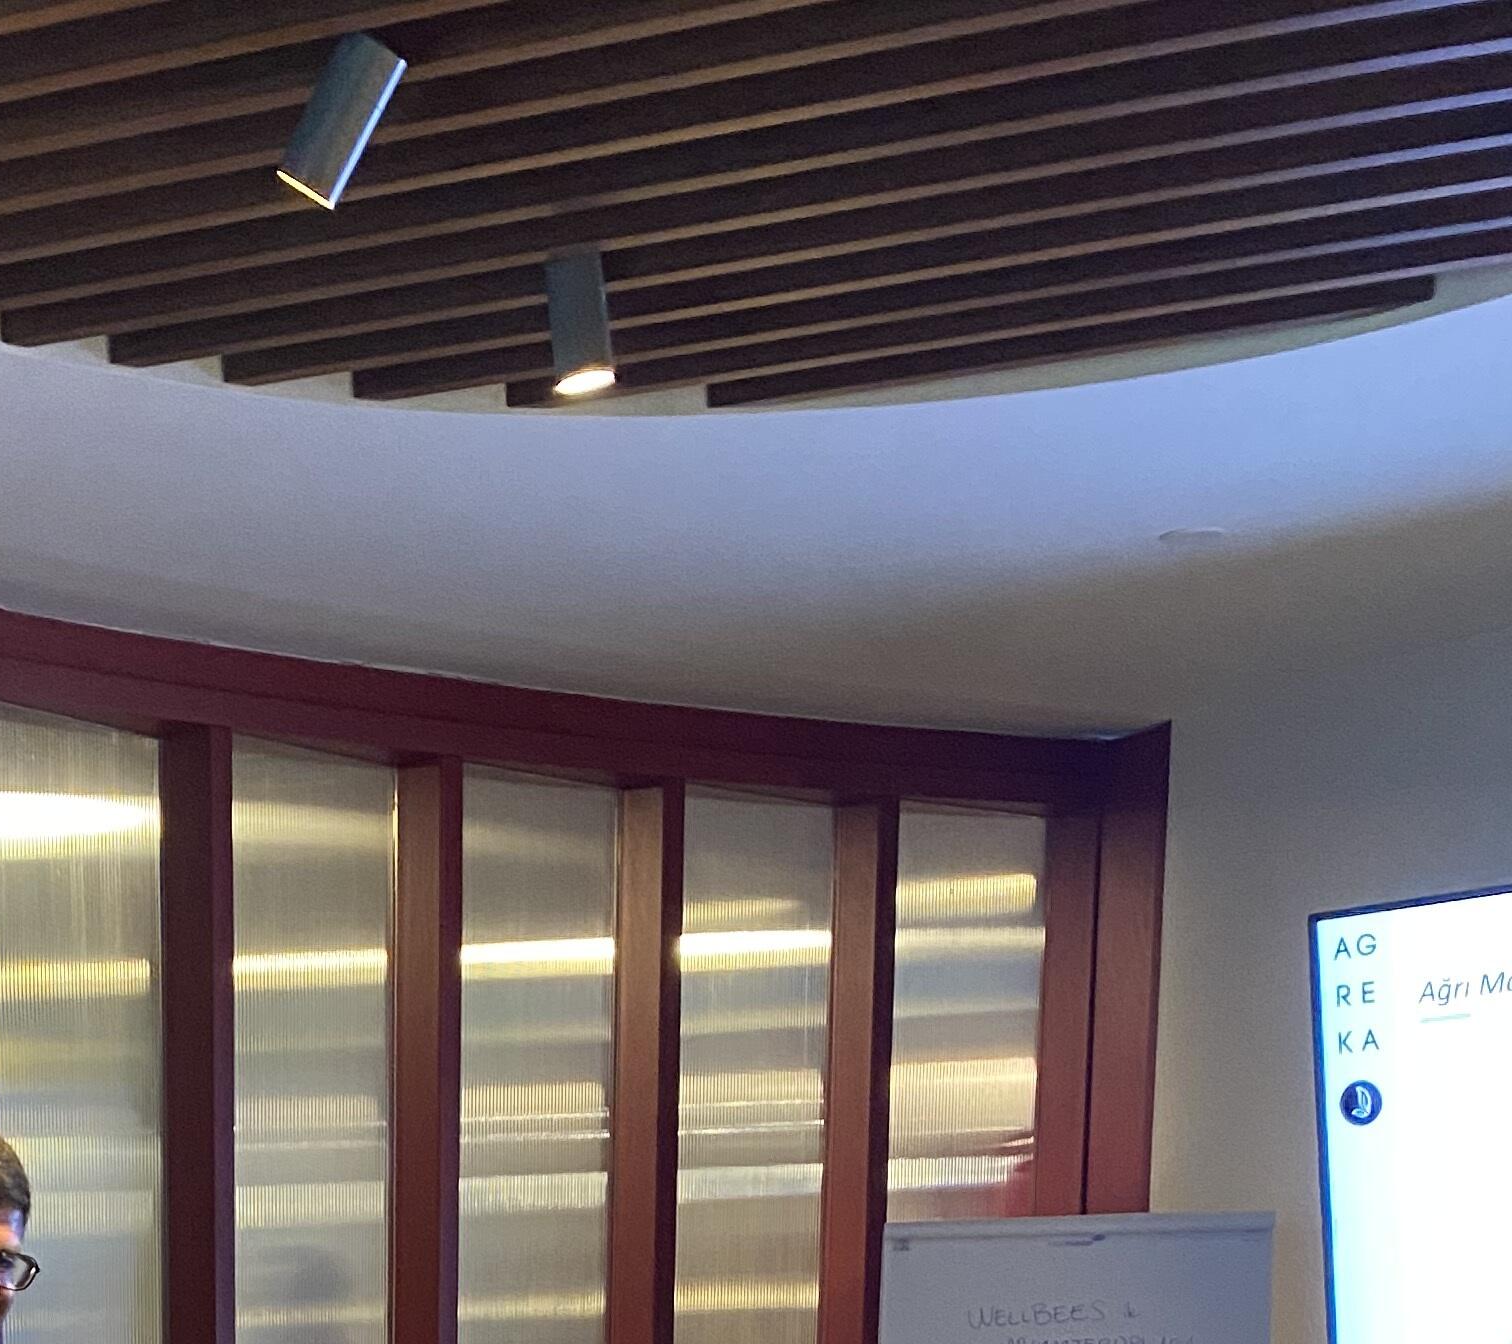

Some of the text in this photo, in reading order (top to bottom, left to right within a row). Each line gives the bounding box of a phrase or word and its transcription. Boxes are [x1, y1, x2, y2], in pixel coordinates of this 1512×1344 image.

[1334, 933, 1377, 961] AG
[1336, 981, 1375, 1007] RE
[1418, 978, 1470, 1006] Ağrı
[1338, 1029, 1380, 1055] KA
[967, 1301, 1105, 1331] WELLBEES
